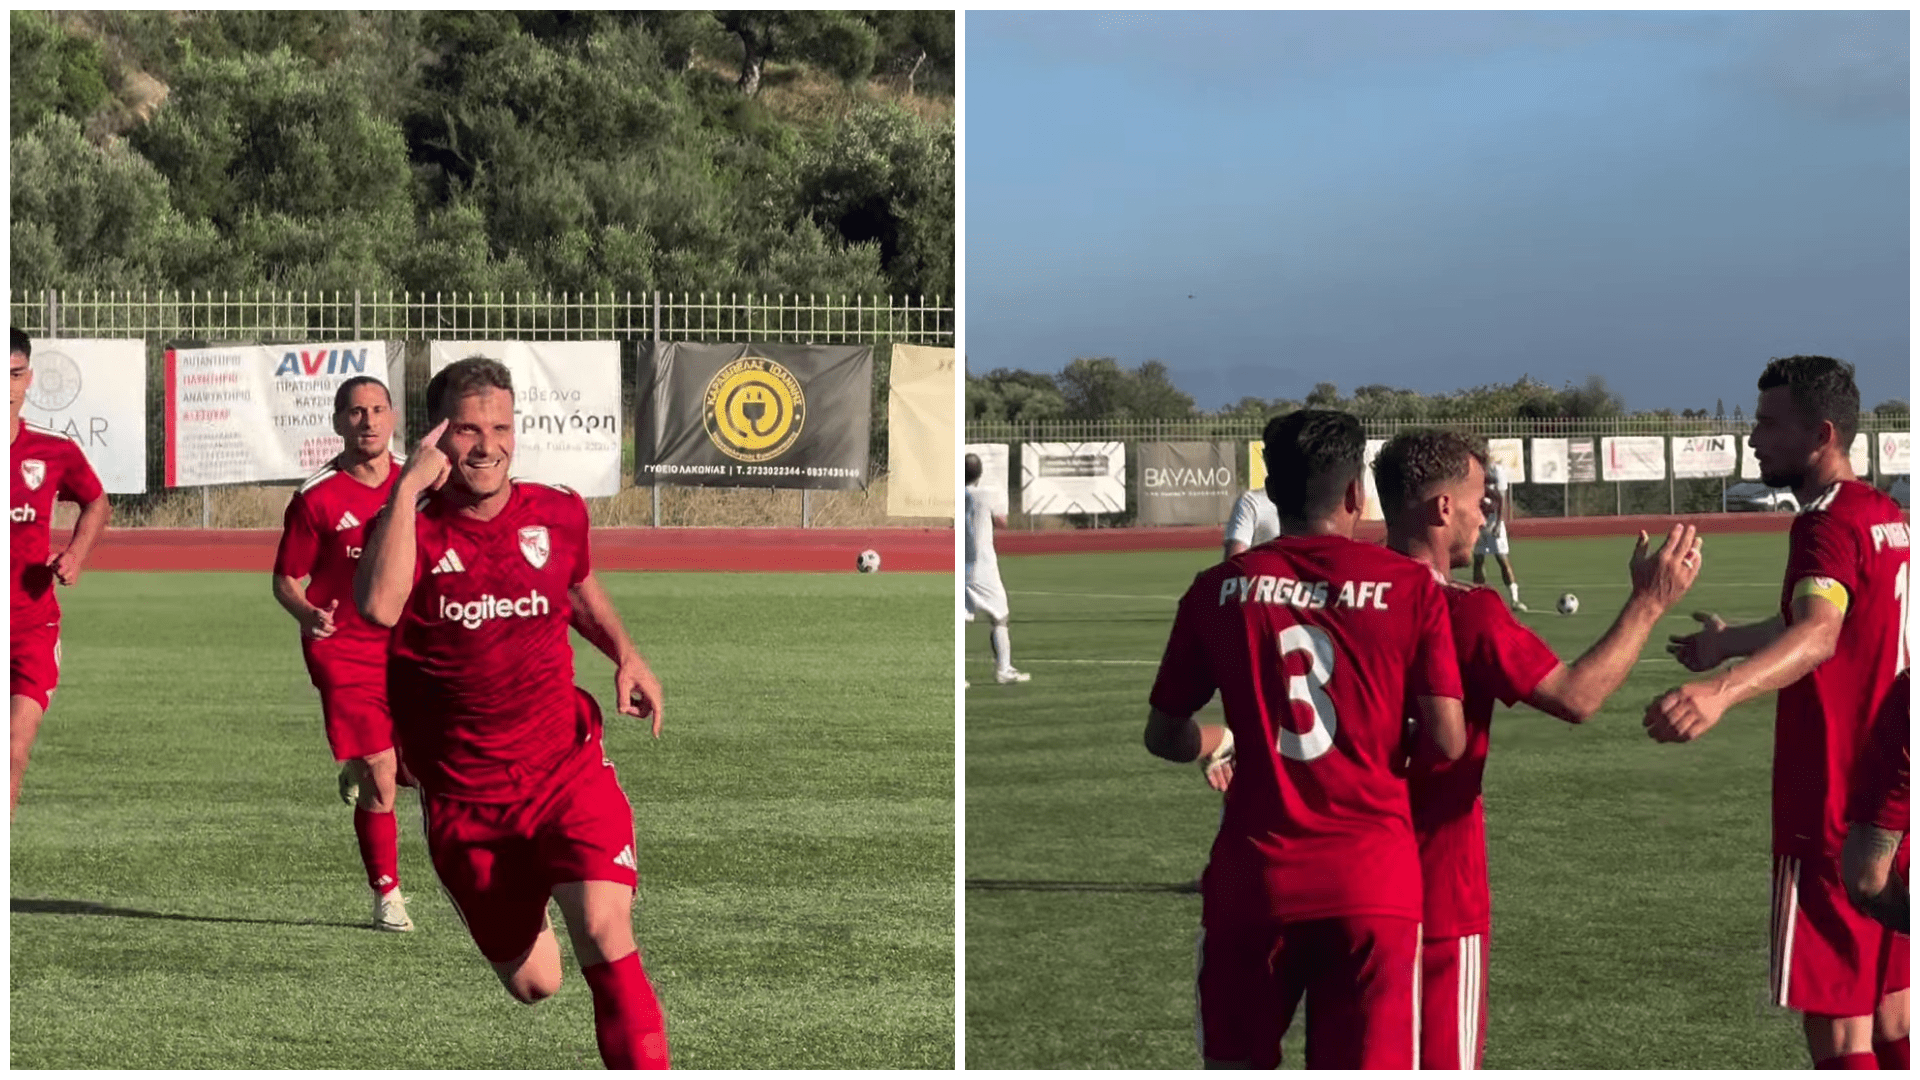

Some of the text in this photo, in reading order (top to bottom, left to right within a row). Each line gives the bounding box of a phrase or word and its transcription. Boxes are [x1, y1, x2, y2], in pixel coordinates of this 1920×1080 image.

[275, 348, 367, 377] AVIN
[1683, 438, 1726, 452] AVIN
[1144, 466, 1231, 487] BAYAMO
[1219, 575, 1393, 610] PYRGOS AFC
[439, 589, 550, 630] logitech
[1276, 624, 1337, 762] 3
